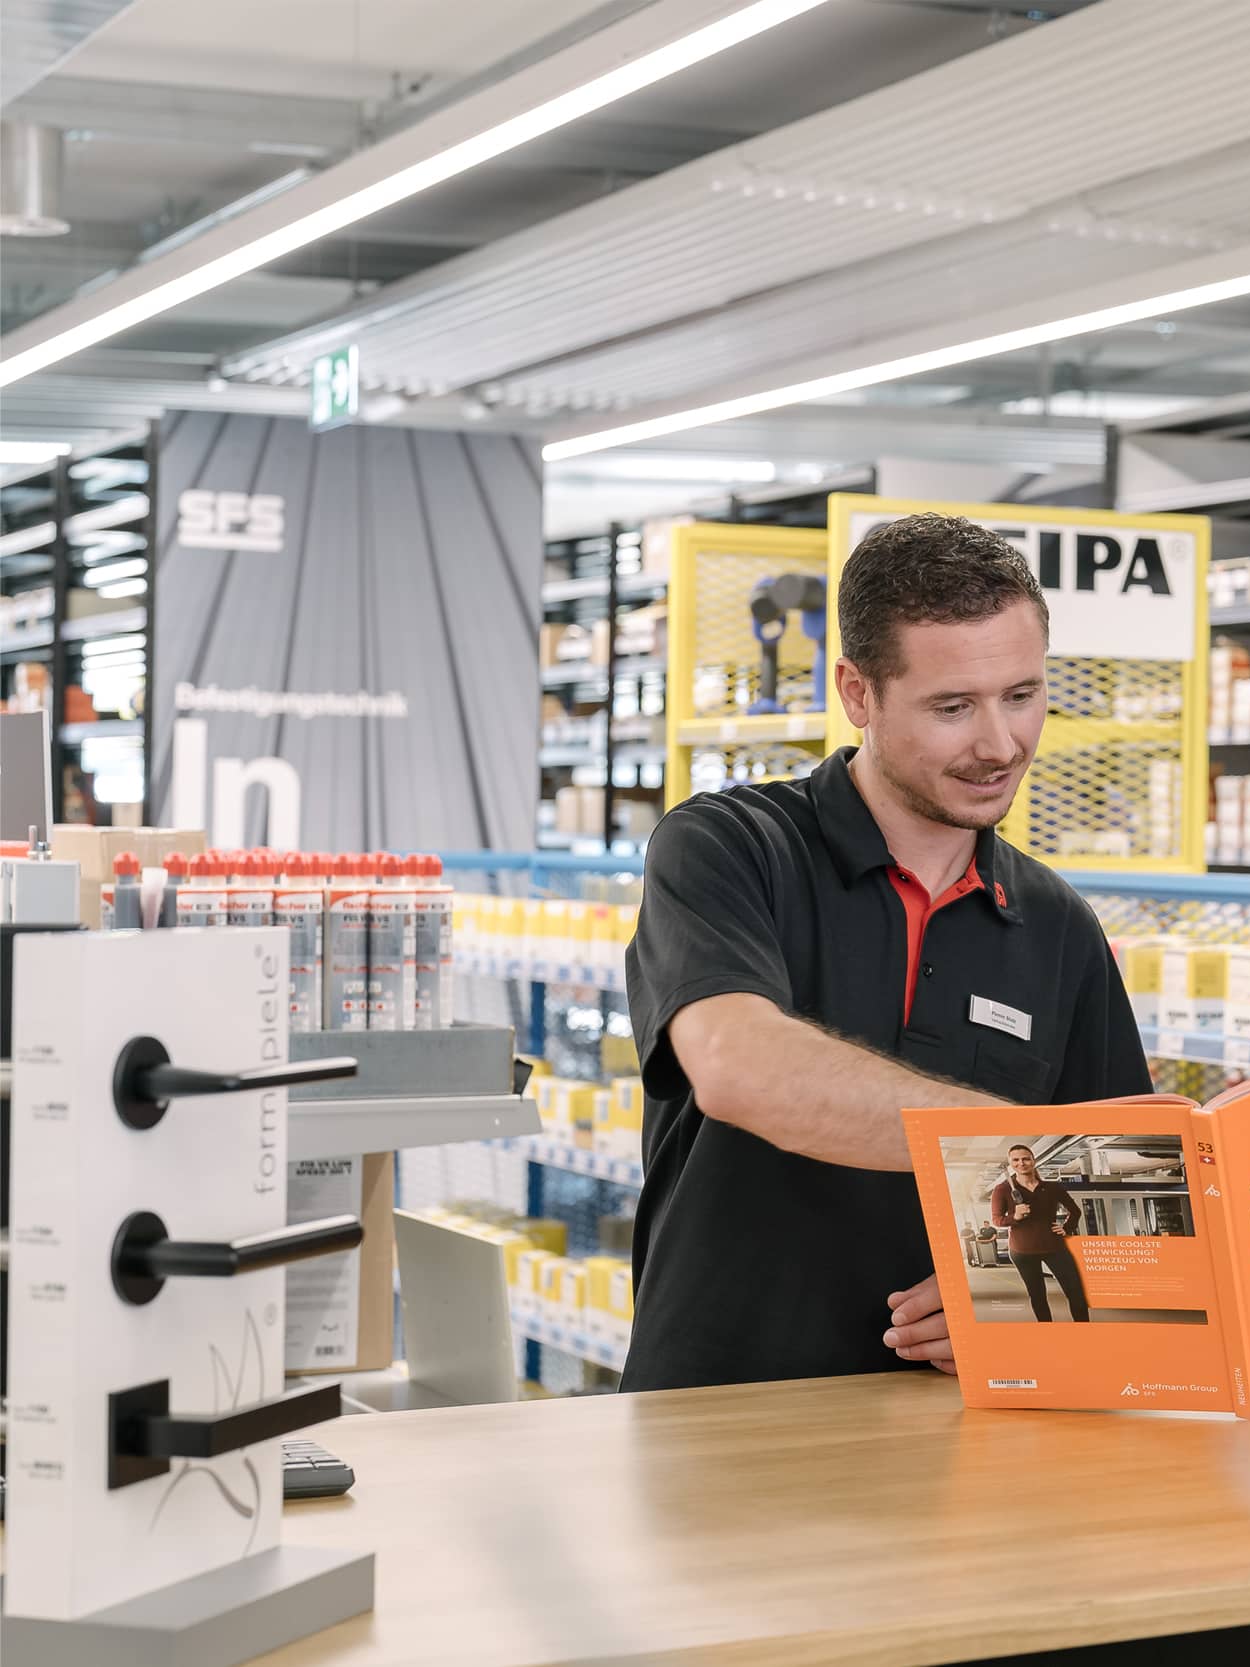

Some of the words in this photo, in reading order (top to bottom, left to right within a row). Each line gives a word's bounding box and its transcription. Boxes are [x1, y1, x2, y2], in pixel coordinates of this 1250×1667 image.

[178, 490, 285, 538] SFS
[1198, 1142, 1213, 1153] 53
[1119, 1241, 1161, 1249] COOLSTE
[1142, 1383, 1188, 1392] Hoffmann
[1189, 1384, 1218, 1393] Group
